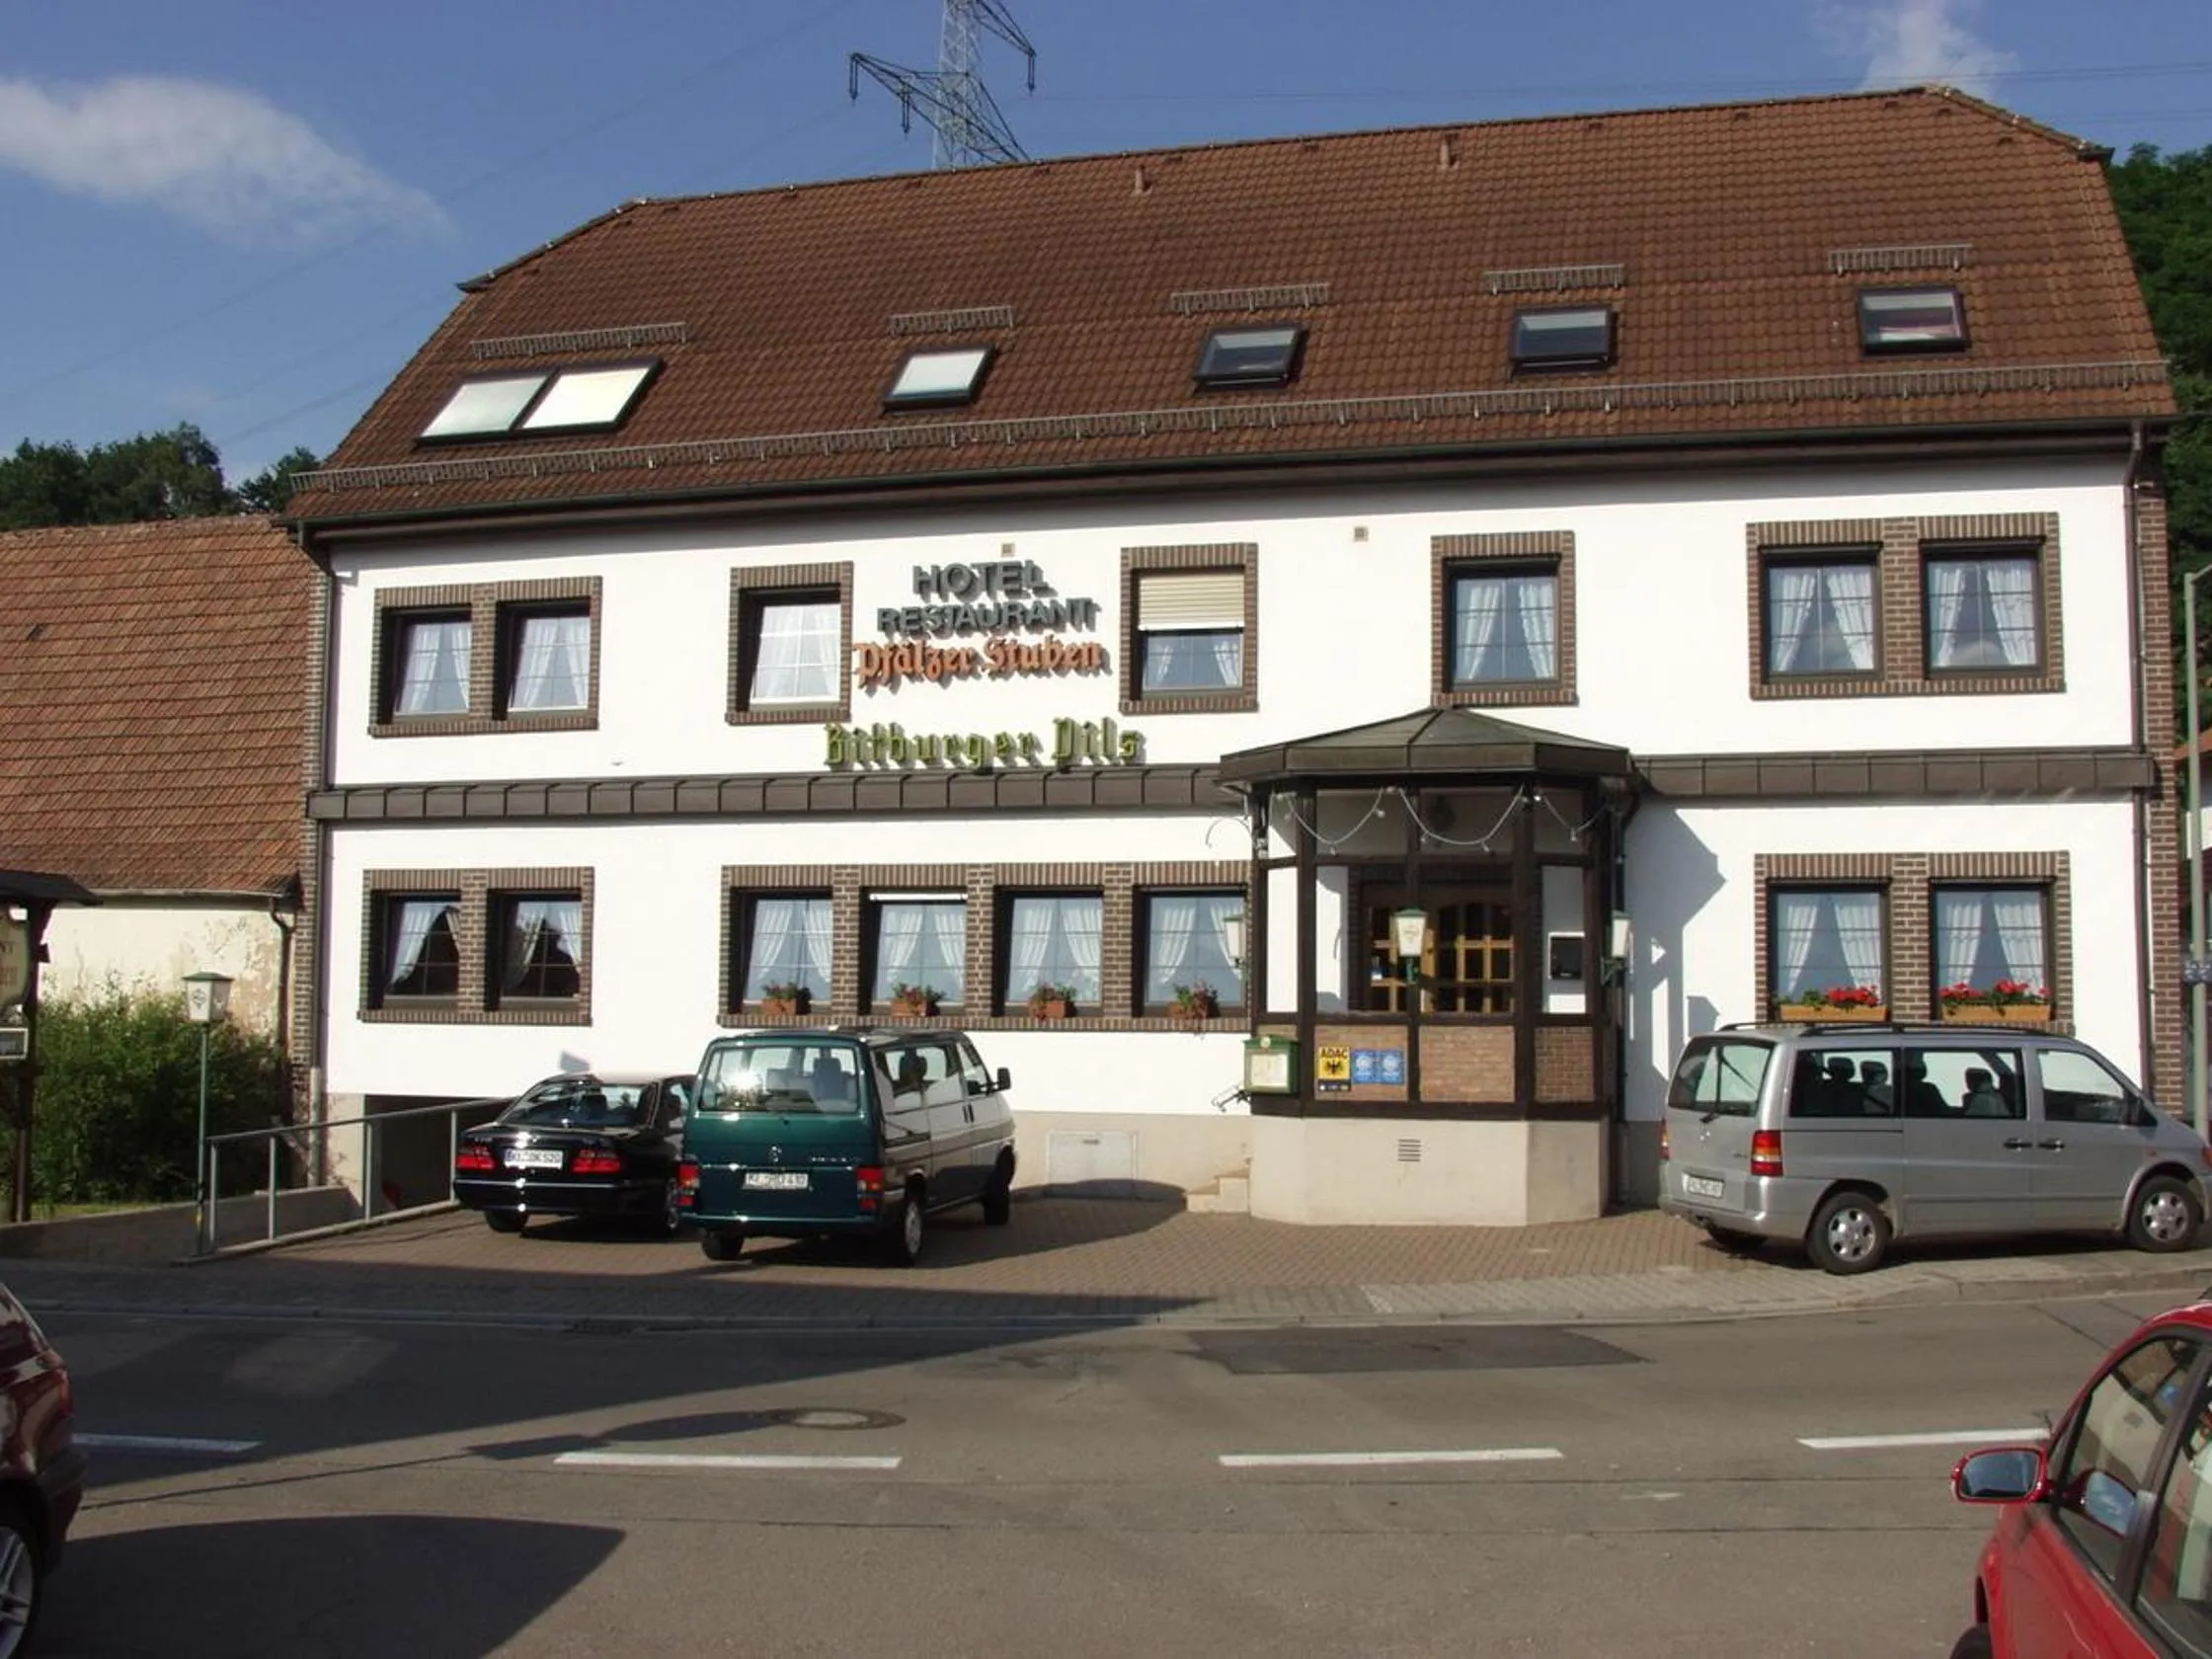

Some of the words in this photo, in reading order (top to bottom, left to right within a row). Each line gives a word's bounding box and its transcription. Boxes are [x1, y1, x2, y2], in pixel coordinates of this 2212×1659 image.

[912, 559, 1051, 597] HOTEL
[877, 596, 1096, 634] RESTAURANT
[853, 636, 977, 687] Pfälzer
[983, 634, 1102, 675] Stuben
[825, 721, 1040, 767] Bitburger
[1052, 716, 1142, 763] Pils
[1319, 1047, 1349, 1059] ADAC
